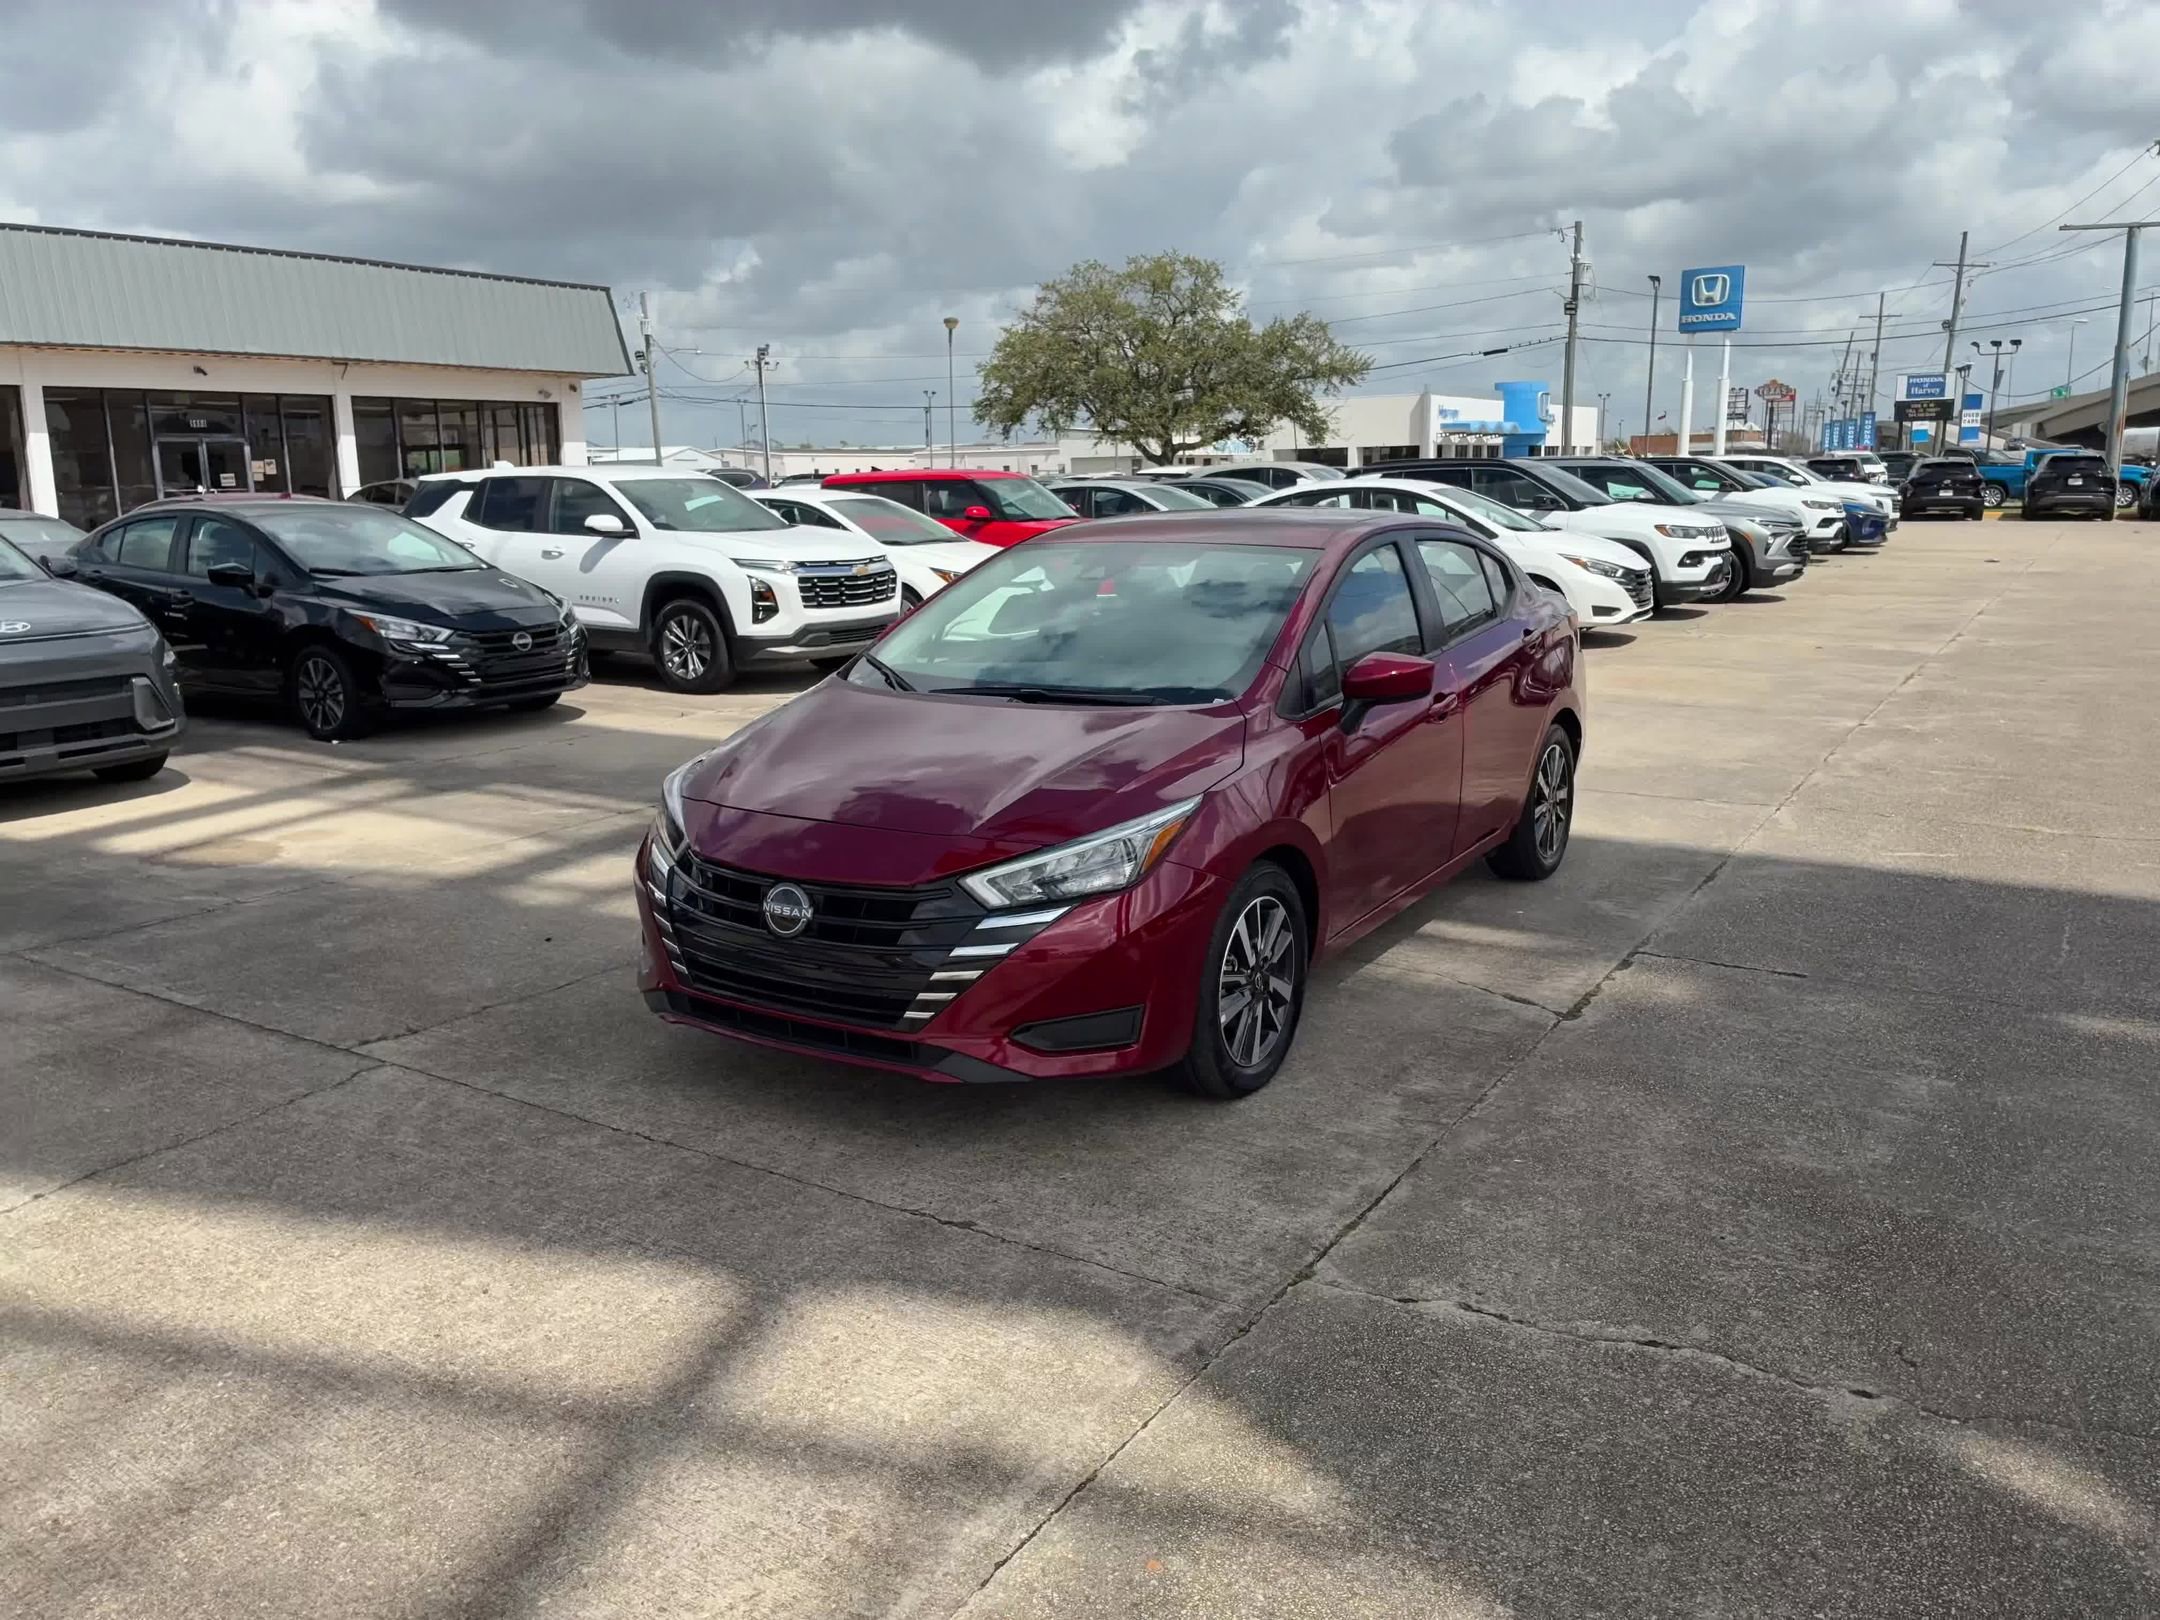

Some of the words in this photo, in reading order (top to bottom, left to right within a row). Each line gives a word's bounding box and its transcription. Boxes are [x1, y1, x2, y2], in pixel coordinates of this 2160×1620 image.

[1681, 312, 1736, 323] HONDA
[1909, 376, 1944, 384] HONDA
[1911, 387, 1940, 395] Harvey
[763, 900, 812, 918] NISSAN
